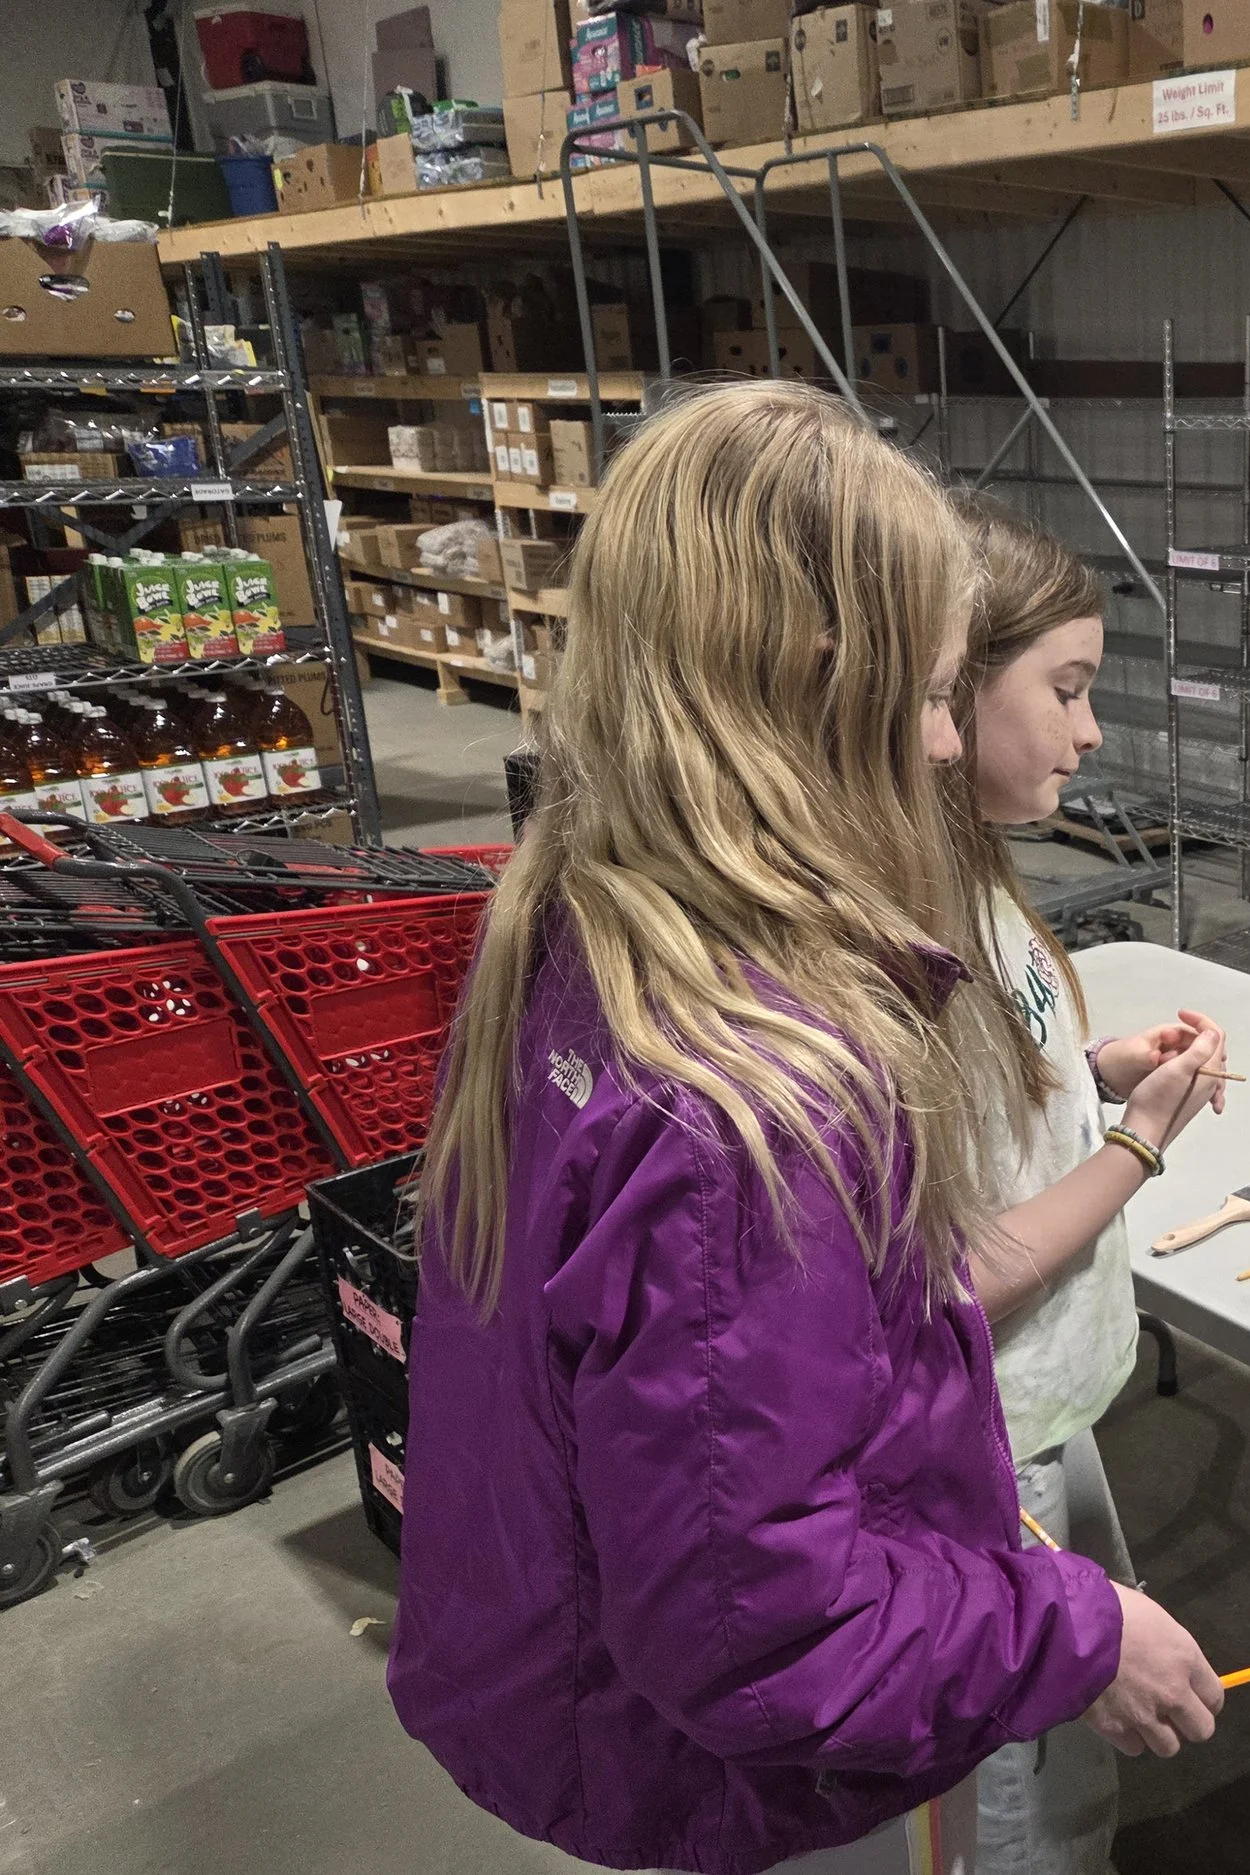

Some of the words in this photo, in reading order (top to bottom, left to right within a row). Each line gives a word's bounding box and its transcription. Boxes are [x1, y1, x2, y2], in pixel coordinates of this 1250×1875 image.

[1162, 87, 1196, 100] Weight
[1199, 82, 1224, 95] Limit
[1158, 112, 1169, 123] 25
[1171, 110, 1188, 123] lbs.
[1197, 106, 1213, 119] Sq.
[1216, 103, 1229, 115] Ft.
[547, 1048, 582, 1086] NORTH
[567, 1048, 585, 1073] THE
[547, 1068, 576, 1097] FACE
[368, 1321, 400, 1354] DOUBLE
